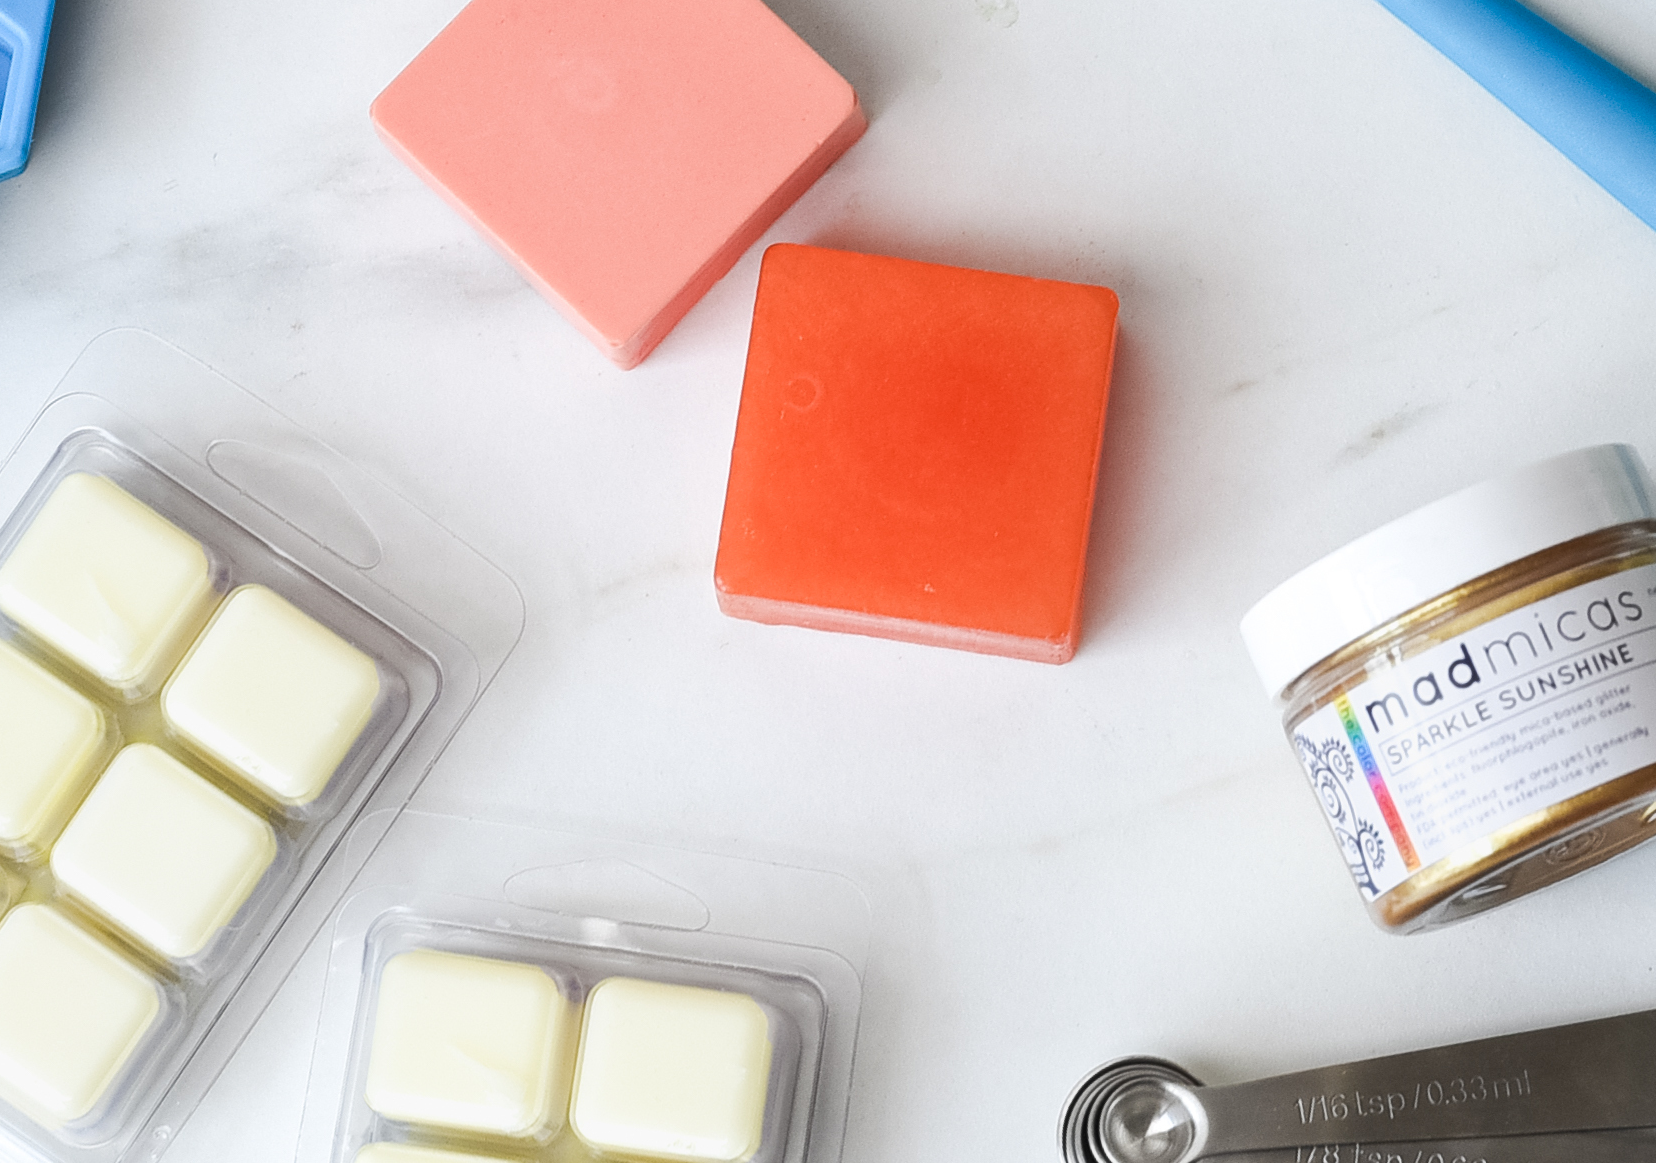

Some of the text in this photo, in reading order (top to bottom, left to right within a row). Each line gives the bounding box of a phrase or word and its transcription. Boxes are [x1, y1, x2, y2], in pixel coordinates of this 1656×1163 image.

[1365, 591, 1643, 733] madmicas
[1387, 643, 1634, 765] SPARKLE SUNSHINE
[1352, 734, 1378, 778] color
[1529, 761, 1560, 781] area
[1561, 751, 1584, 769] yes
[1560, 768, 1584, 783] use
[1586, 757, 1609, 775] yes
[1295, 1093, 1349, 1126] 1/16
[1355, 1090, 1406, 1120] tsp
